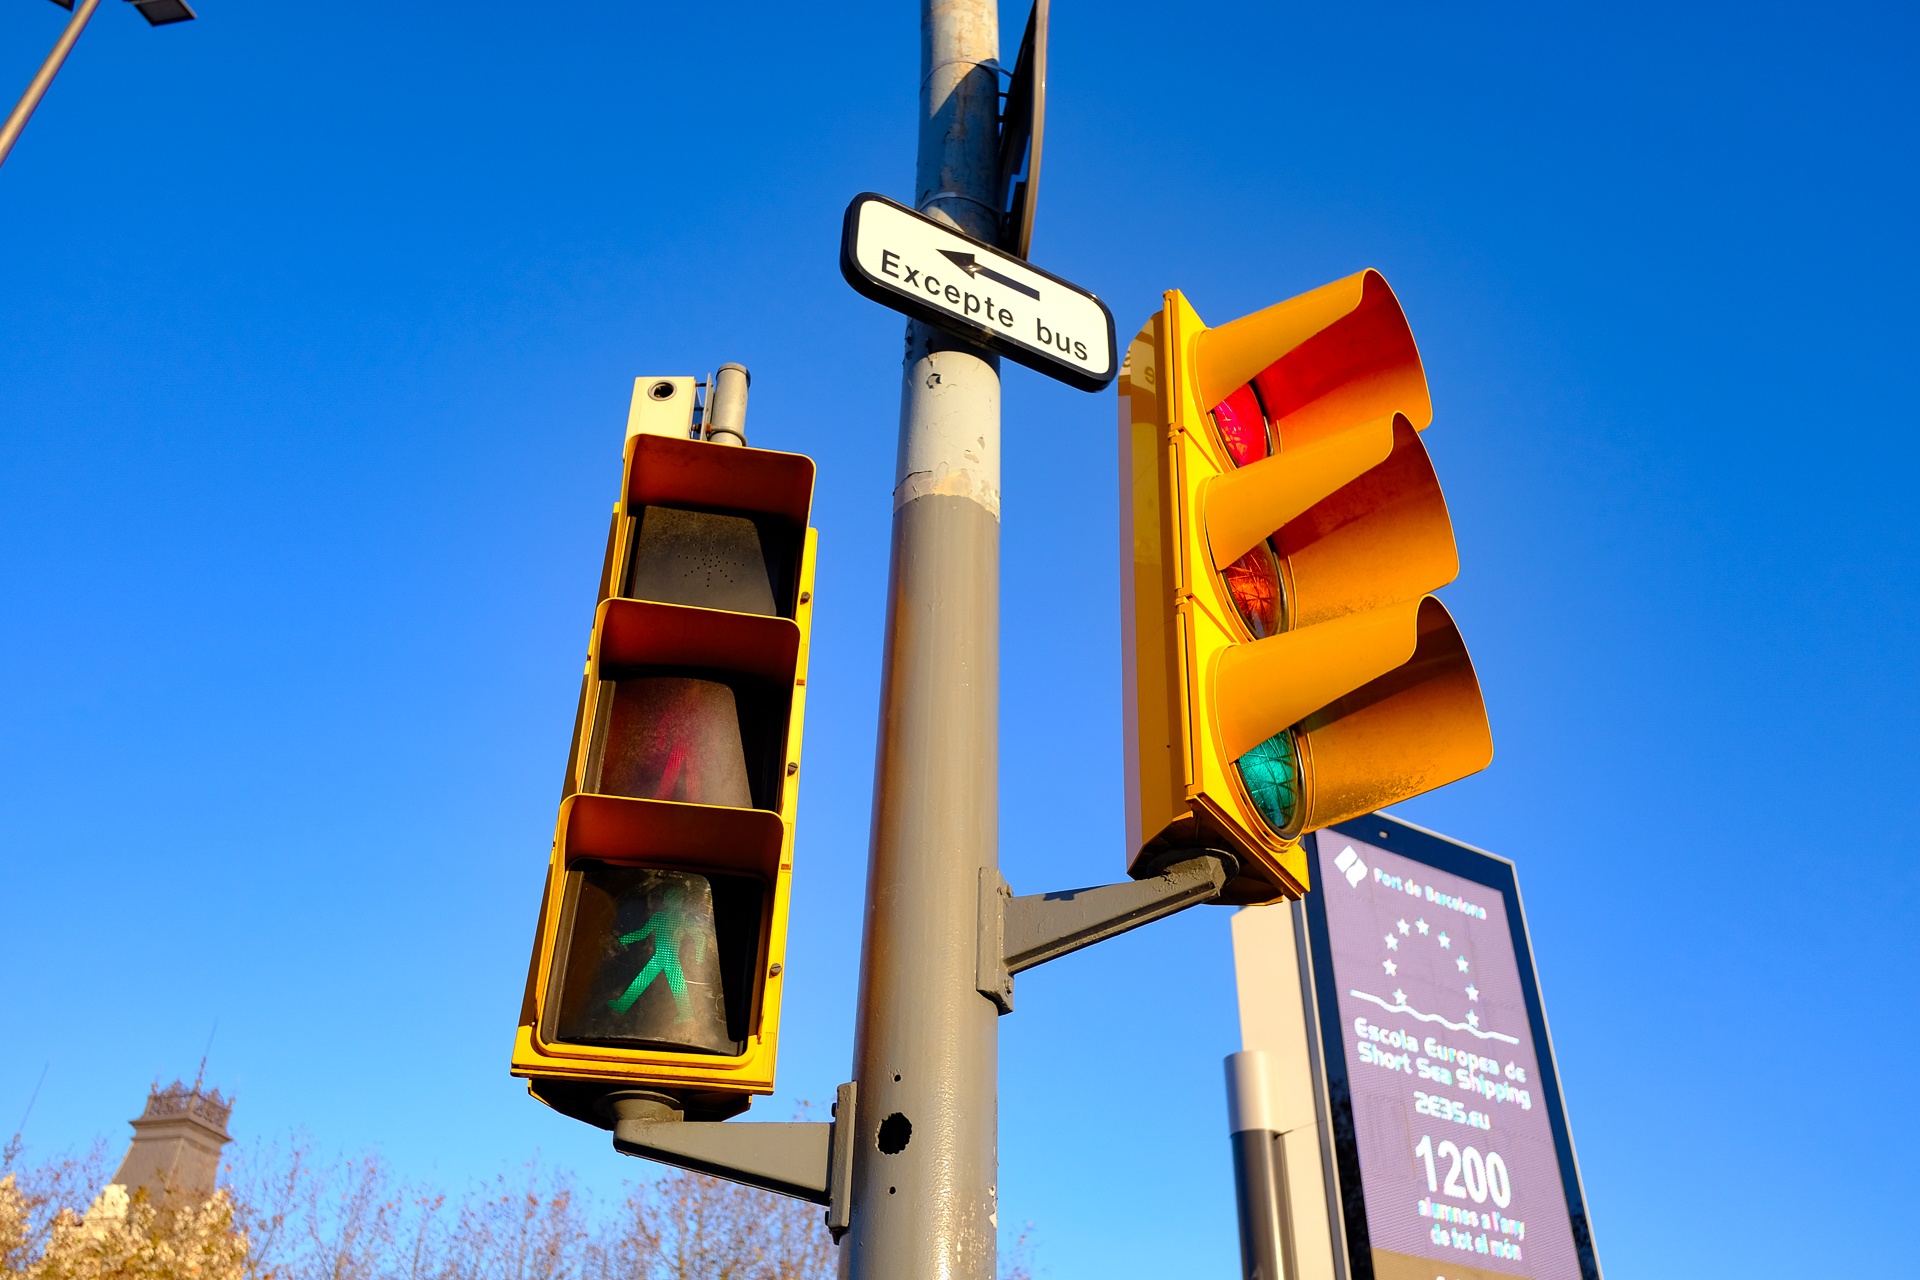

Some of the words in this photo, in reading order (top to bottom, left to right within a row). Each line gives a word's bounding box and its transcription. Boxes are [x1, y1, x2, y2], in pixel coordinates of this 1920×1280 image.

[881, 249, 1014, 328] Excepte
[1036, 317, 1089, 361] bus
[1373, 867, 1403, 892] Port
[1404, 878, 1423, 898] de
[1424, 885, 1488, 921] Barcelona
[1354, 1016, 1420, 1053] Escola
[1424, 1036, 1500, 1076] Europea
[1504, 1060, 1527, 1083] de
[1357, 1040, 1413, 1075] Short
[1416, 1057, 1453, 1086] Sea
[1456, 1068, 1532, 1111] Shipping
[1415, 1134, 1511, 1209] 1200
[1430, 1223, 1451, 1247] de
